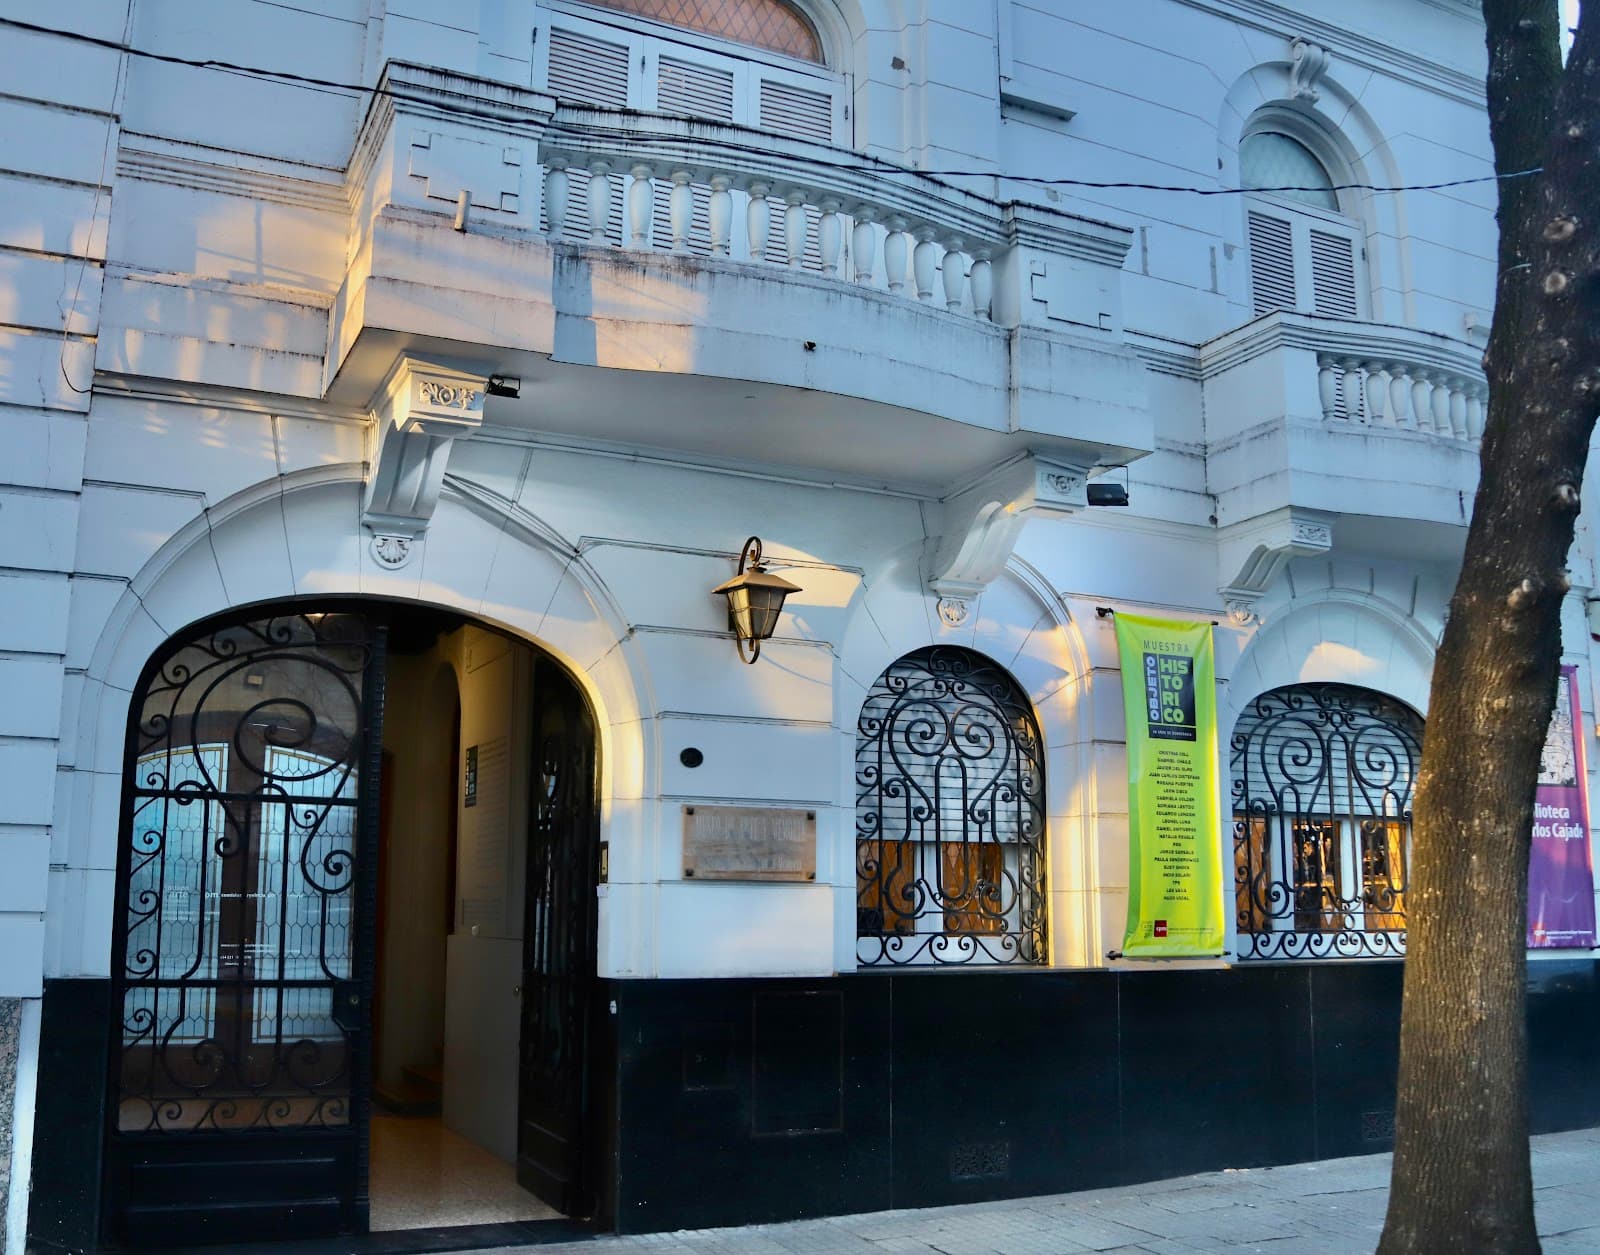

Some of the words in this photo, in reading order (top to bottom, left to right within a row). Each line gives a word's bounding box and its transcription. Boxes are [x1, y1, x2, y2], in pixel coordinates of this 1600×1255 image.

[1143, 640, 1189, 652] MUESTRA
[1160, 658, 1188, 674] HIS
[1146, 656, 1159, 720] OBJETO
[1162, 691, 1179, 706] RI
[1163, 707, 1184, 723] CO
[1533, 802, 1570, 819] lioteca
[1532, 822, 1551, 838] rlos
